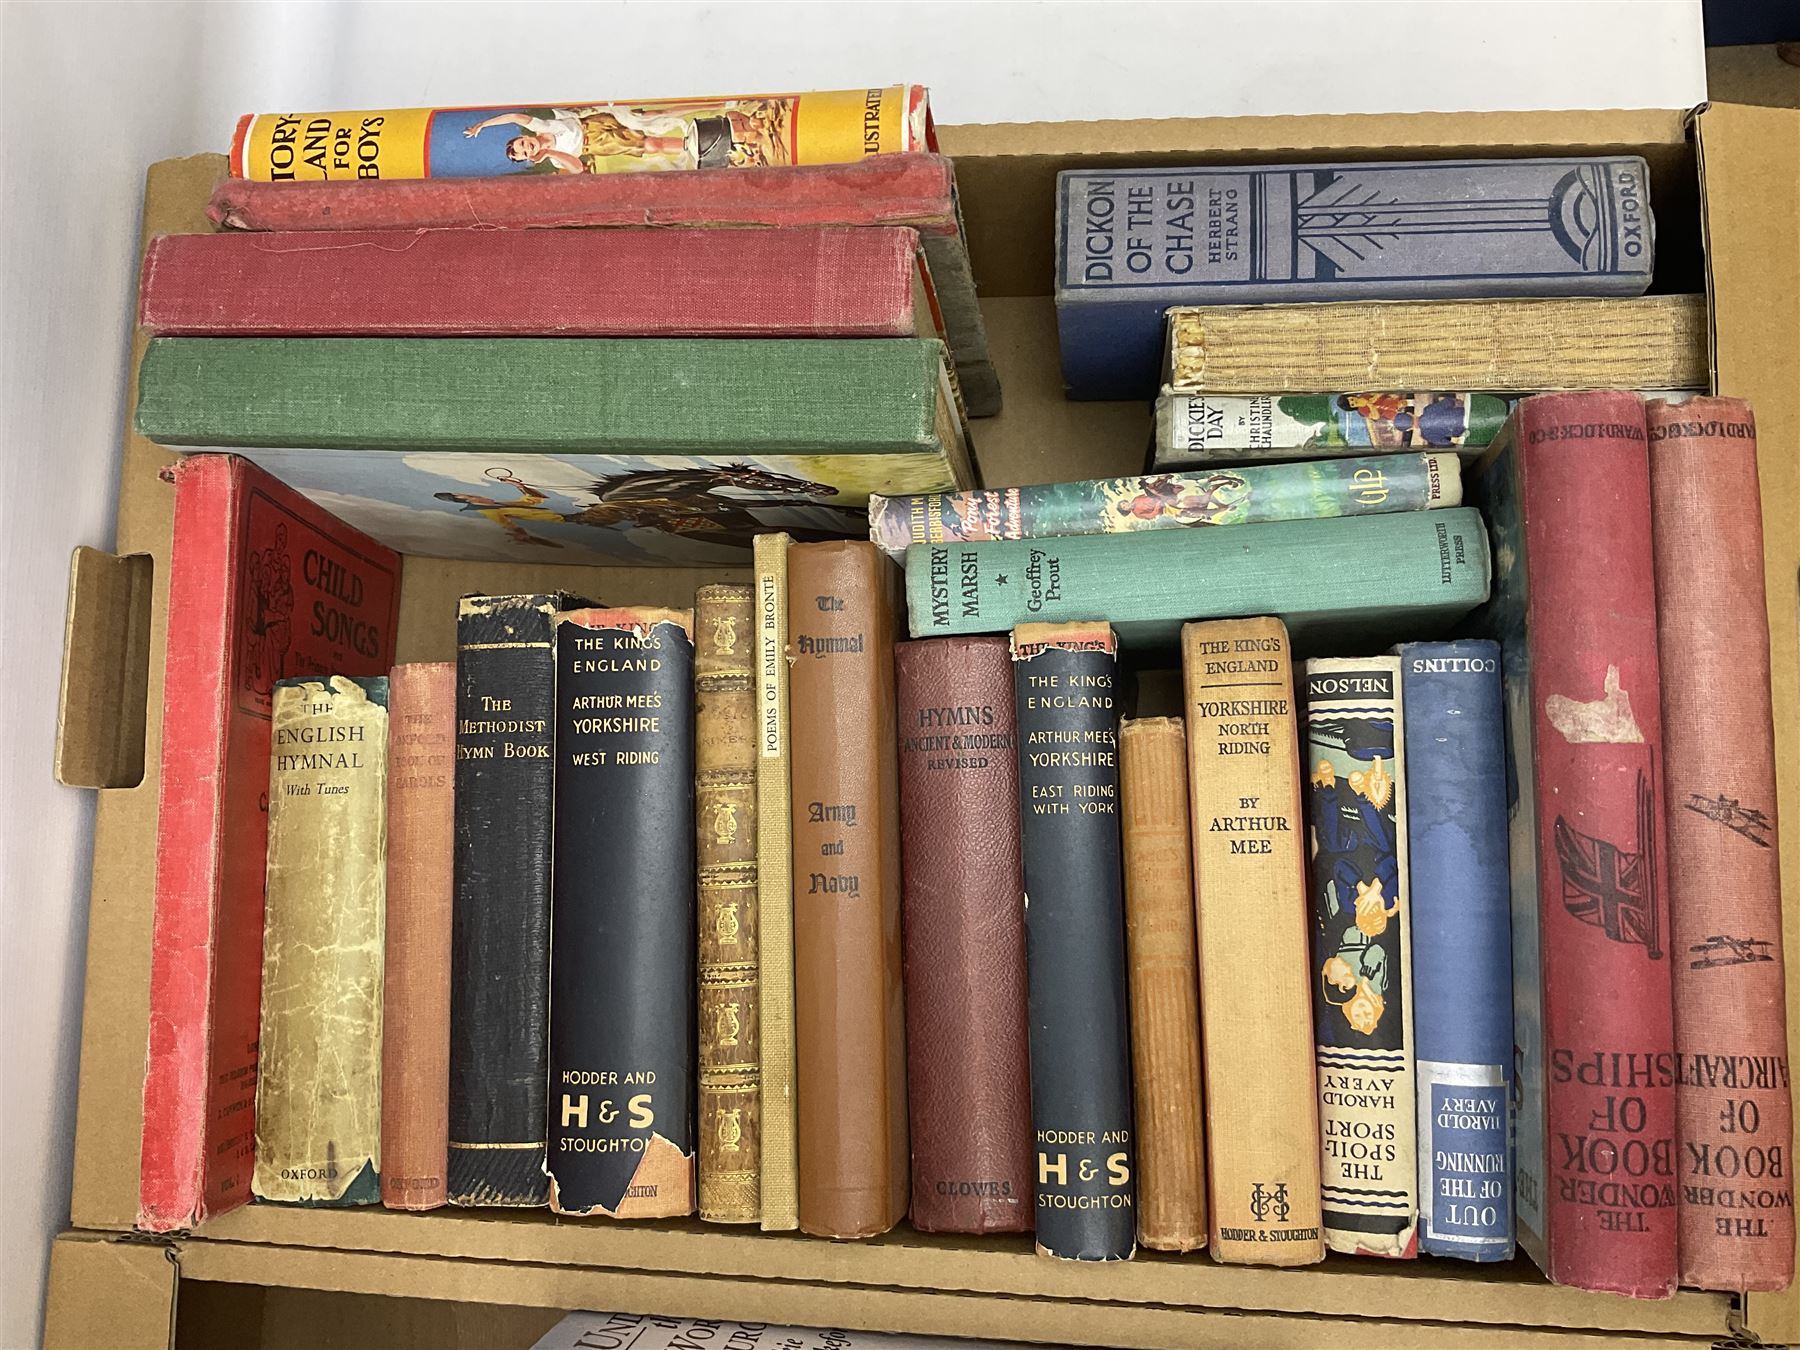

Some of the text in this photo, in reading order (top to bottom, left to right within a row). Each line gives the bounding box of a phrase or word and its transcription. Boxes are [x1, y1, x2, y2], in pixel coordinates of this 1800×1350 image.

[864, 88, 883, 155] USTRATED
[271, 113, 302, 182] TORY-
[334, 127, 352, 170] FOR
[358, 116, 384, 180] BOYS
[1619, 172, 1643, 257] OXFORD
[1085, 180, 1115, 281] DICKON
[1126, 186, 1153, 274] OF THE
[1165, 180, 1194, 275] CHASE
[1208, 188, 1222, 264] HERBERT
[1206, 406, 1225, 440] DAY
[1238, 415, 1247, 427] BY
[1428, 456, 1441, 500] PRESS LTD.
[928, 493, 944, 544] BERRISFOR
[960, 494, 981, 535] Pony
[983, 490, 1000, 535] Forest
[1004, 487, 1023, 540] Adventure
[911, 506, 926, 544] JUDITH
[1435, 522, 1451, 584] LUTTERWORTH
[1453, 535, 1466, 565] PRESS
[303, 549, 364, 608] CHILD
[931, 546, 950, 627] MYSTERY
[961, 551, 979, 618] MARSH
[1027, 548, 1047, 613] Geoffrey
[1046, 557, 1061, 601] Prout
[816, 595, 844, 612] The
[310, 600, 379, 658] SONGS
[575, 634, 661, 651] THE KING'S
[797, 633, 864, 659] Hymnal
[1200, 637, 1281, 655] THE KING'S
[573, 658, 661, 673] ENGLAND
[765, 637, 776, 676] EMILY
[1413, 658, 1496, 673] COLLINS
[1205, 659, 1279, 675] ENGLAND
[1028, 674, 1113, 688] THE KING'S
[1309, 678, 1389, 695] NELSON
[572, 690, 662, 710] ARTHUR MEE'S
[766, 683, 776, 701] OF
[481, 696, 512, 712] THE
[1028, 696, 1113, 709] ENGLAND
[1198, 700, 1289, 718] YORKSHIRE
[459, 719, 546, 735] METHODIST
[572, 717, 660, 735] YORKSHIRE
[919, 706, 994, 728] HYMNS
[277, 726, 365, 745] ENGLISH
[767, 708, 778, 751] POEMS
[1028, 728, 1114, 745] ARTHUR MEE'S
[1218, 722, 1270, 736] NORTH
[504, 742, 550, 758] BOOK
[904, 734, 1012, 752] ANCIENT & MODERN
[1218, 741, 1271, 755] RIDING
[277, 752, 364, 771] HYMNAL
[572, 751, 660, 766] WEST RIDING
[927, 757, 988, 770] REVISED
[1029, 751, 1114, 767] YORKSHIRE
[286, 782, 350, 796] With Tunes
[1032, 784, 1114, 798] EAST RIDING
[1033, 802, 1114, 814] WITH YORK
[1239, 798, 1259, 809] BY
[808, 802, 857, 827] Army
[1209, 817, 1291, 832] ARTHUR
[821, 840, 844, 856] and
[1230, 840, 1272, 854] MEE
[808, 873, 860, 898] Navy
[562, 1071, 657, 1085] HODDER AND
[1553, 1050, 1675, 1088] SHIPS
[1676, 1053, 1788, 1090] AIRCRAFT
[1324, 1074, 1394, 1092] AVERY
[1323, 1091, 1395, 1109] HAROLD
[1441, 1097, 1496, 1113] AVERY
[561, 1094, 655, 1129] H & S
[1437, 1113, 1501, 1130] HAROLD
[1589, 1096, 1647, 1133] OF
[1720, 1099, 1760, 1134] OF
[1037, 1130, 1129, 1145] HODDER AND
[1325, 1119, 1396, 1140] SPORT
[1436, 1150, 1505, 1173] RUNNING
[1558, 1133, 1674, 1177] BOOK
[1685, 1142, 1783, 1178] BOOK
[281, 1168, 338, 1180] OXFORD
[1038, 1152, 1130, 1186] H & S
[1341, 1162, 1383, 1181] THE
[936, 1181, 1012, 1196] CLOWES
[1440, 1178, 1502, 1198] OF THE
[1559, 1176, 1676, 1208] WONDER
[1684, 1185, 1792, 1208] WONDER
[1038, 1193, 1131, 1209] STOUGHTON
[1446, 1205, 1497, 1227] OUT
[1599, 1210, 1650, 1232] THE
[1220, 1227, 1319, 1242] HODDER & STOUGHTON
[1716, 1216, 1768, 1237] THE
